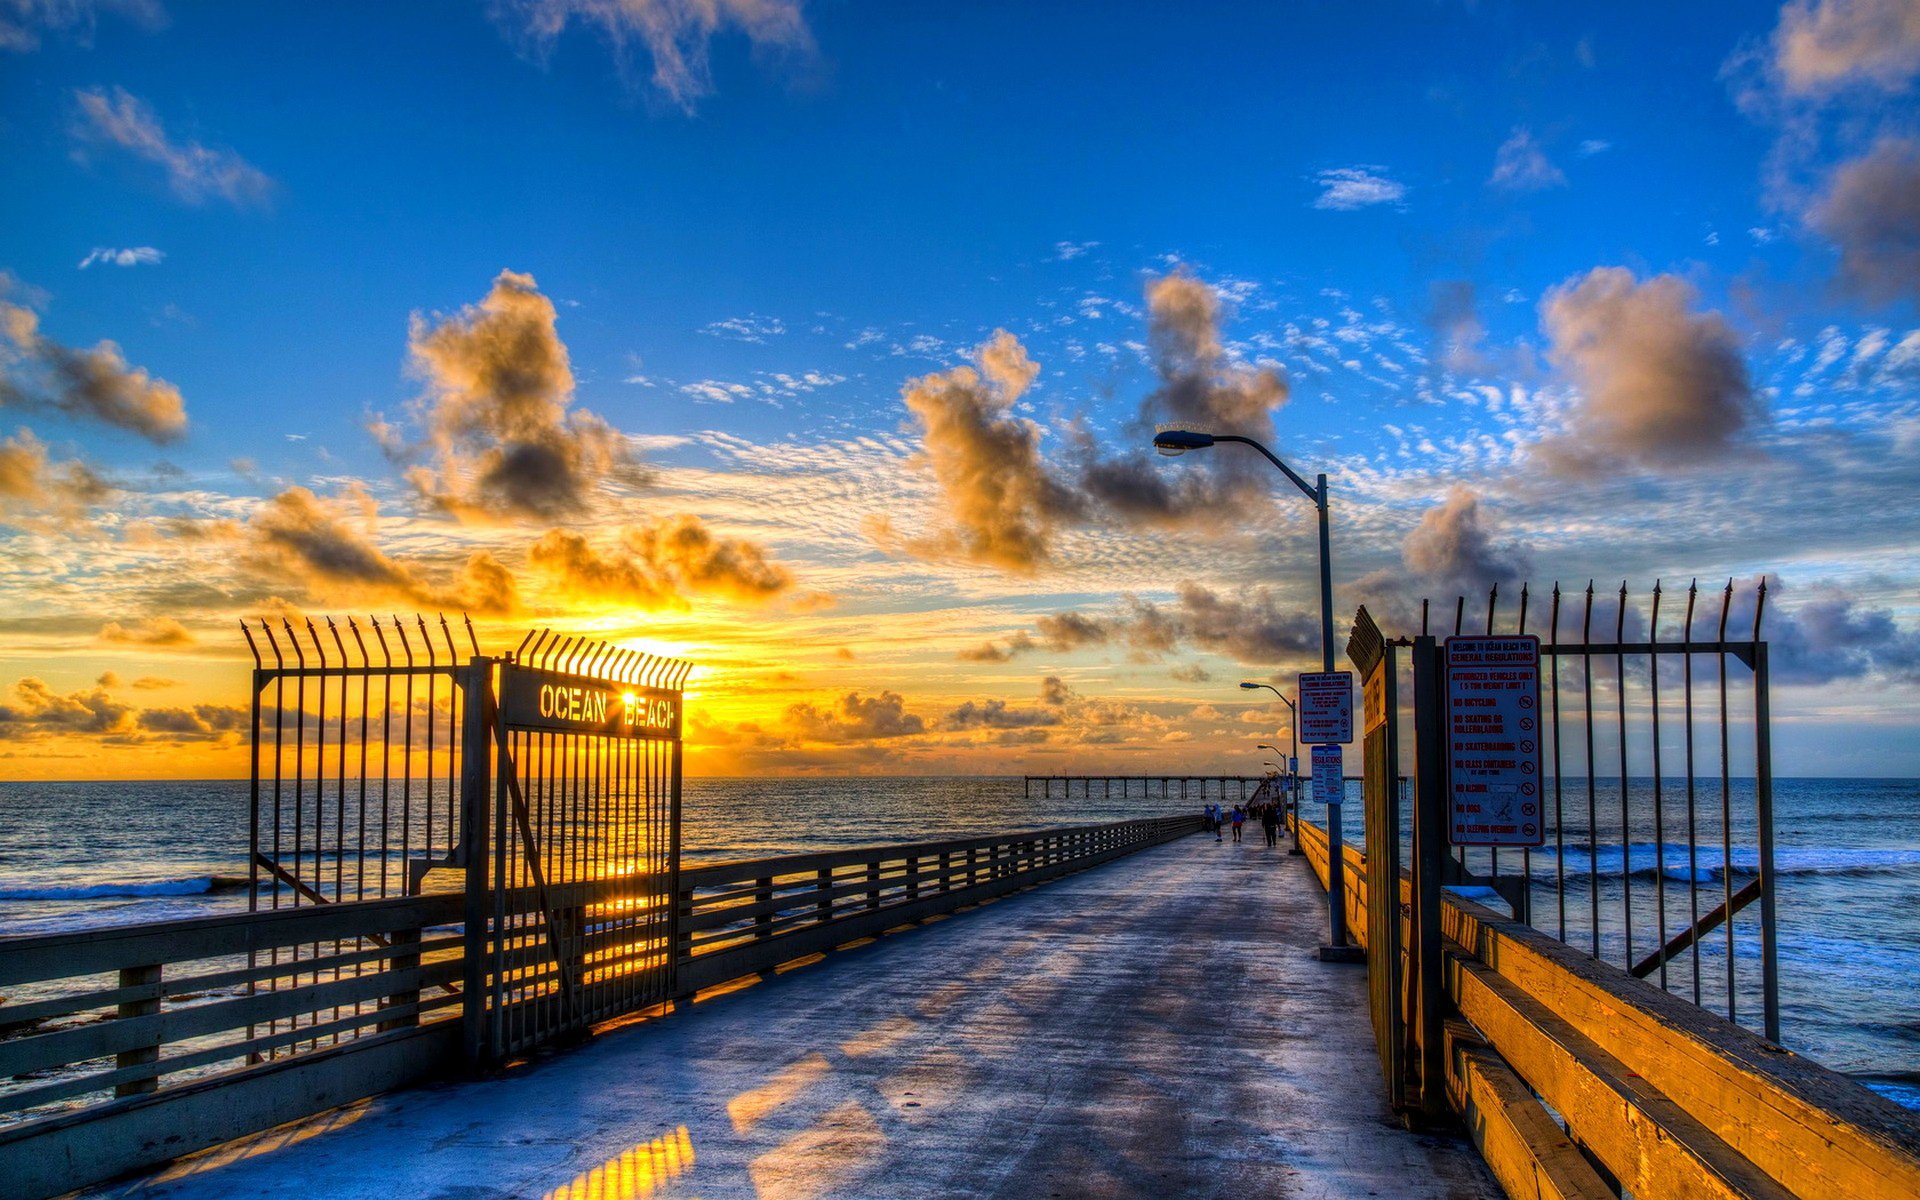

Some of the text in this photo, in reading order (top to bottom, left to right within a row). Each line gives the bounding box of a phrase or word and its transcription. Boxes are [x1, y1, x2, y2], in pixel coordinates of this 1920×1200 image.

[1452, 642, 1476, 652] WELCOME
[1485, 642, 1501, 652] OCEAN
[1502, 642, 1519, 652] BEACH
[1520, 642, 1531, 652] PIER
[1452, 653, 1533, 662] GENERAL REGULATIONS
[540, 684, 674, 729] OCEAN BEACH
[1454, 698, 1497, 707] NO BICYCLING
[1454, 715, 1503, 723] NO SKATING OR
[1454, 725, 1504, 734] ROLLERBLADING
[1455, 742, 1516, 751] NO SKATEBOARDING
[1456, 784, 1487, 792] NO ALCOHOL
[1456, 804, 1480, 813] NO DOGS
[1456, 825, 1517, 833] NO SLEEPING OVERNIGHT
